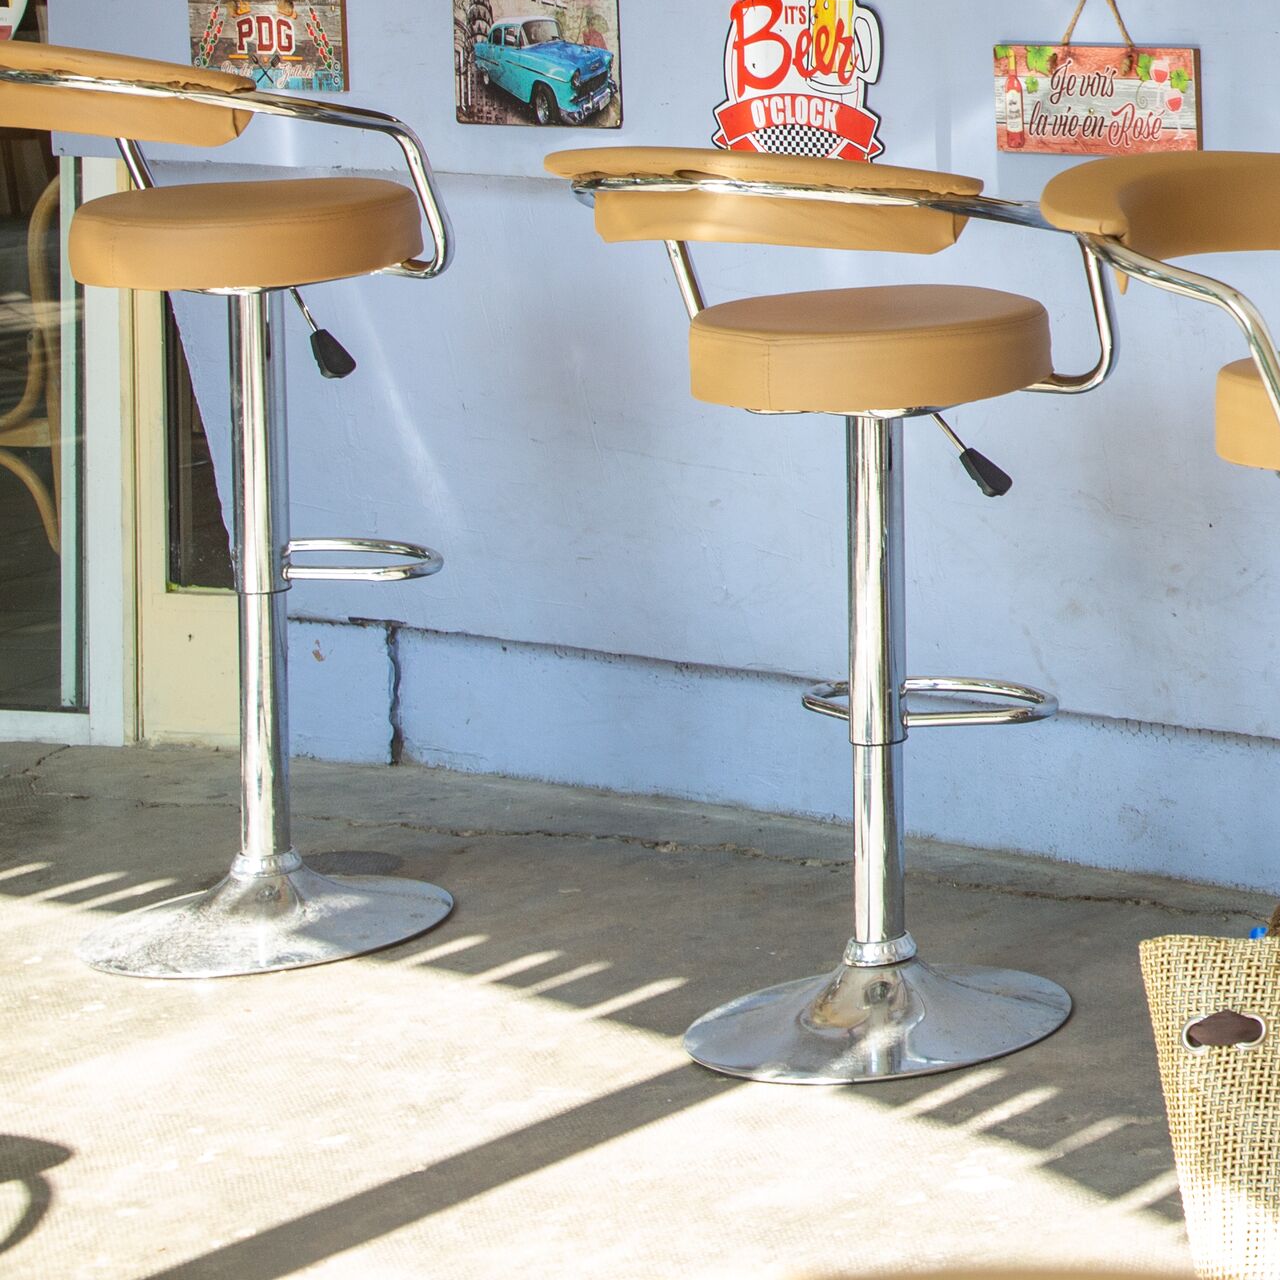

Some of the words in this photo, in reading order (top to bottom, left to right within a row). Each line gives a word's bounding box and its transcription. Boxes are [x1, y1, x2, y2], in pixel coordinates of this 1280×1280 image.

[236, 14, 296, 55] PDG
[784, 5, 807, 25] IT'S
[1049, 59, 1075, 105] Je
[1079, 67, 1117, 98] vois
[750, 94, 841, 132] O'CLOCK
[1029, 100, 1047, 136] la
[1051, 107, 1077, 138] vie
[1081, 112, 1105, 139] en
[1107, 102, 1166, 147] Rosé
